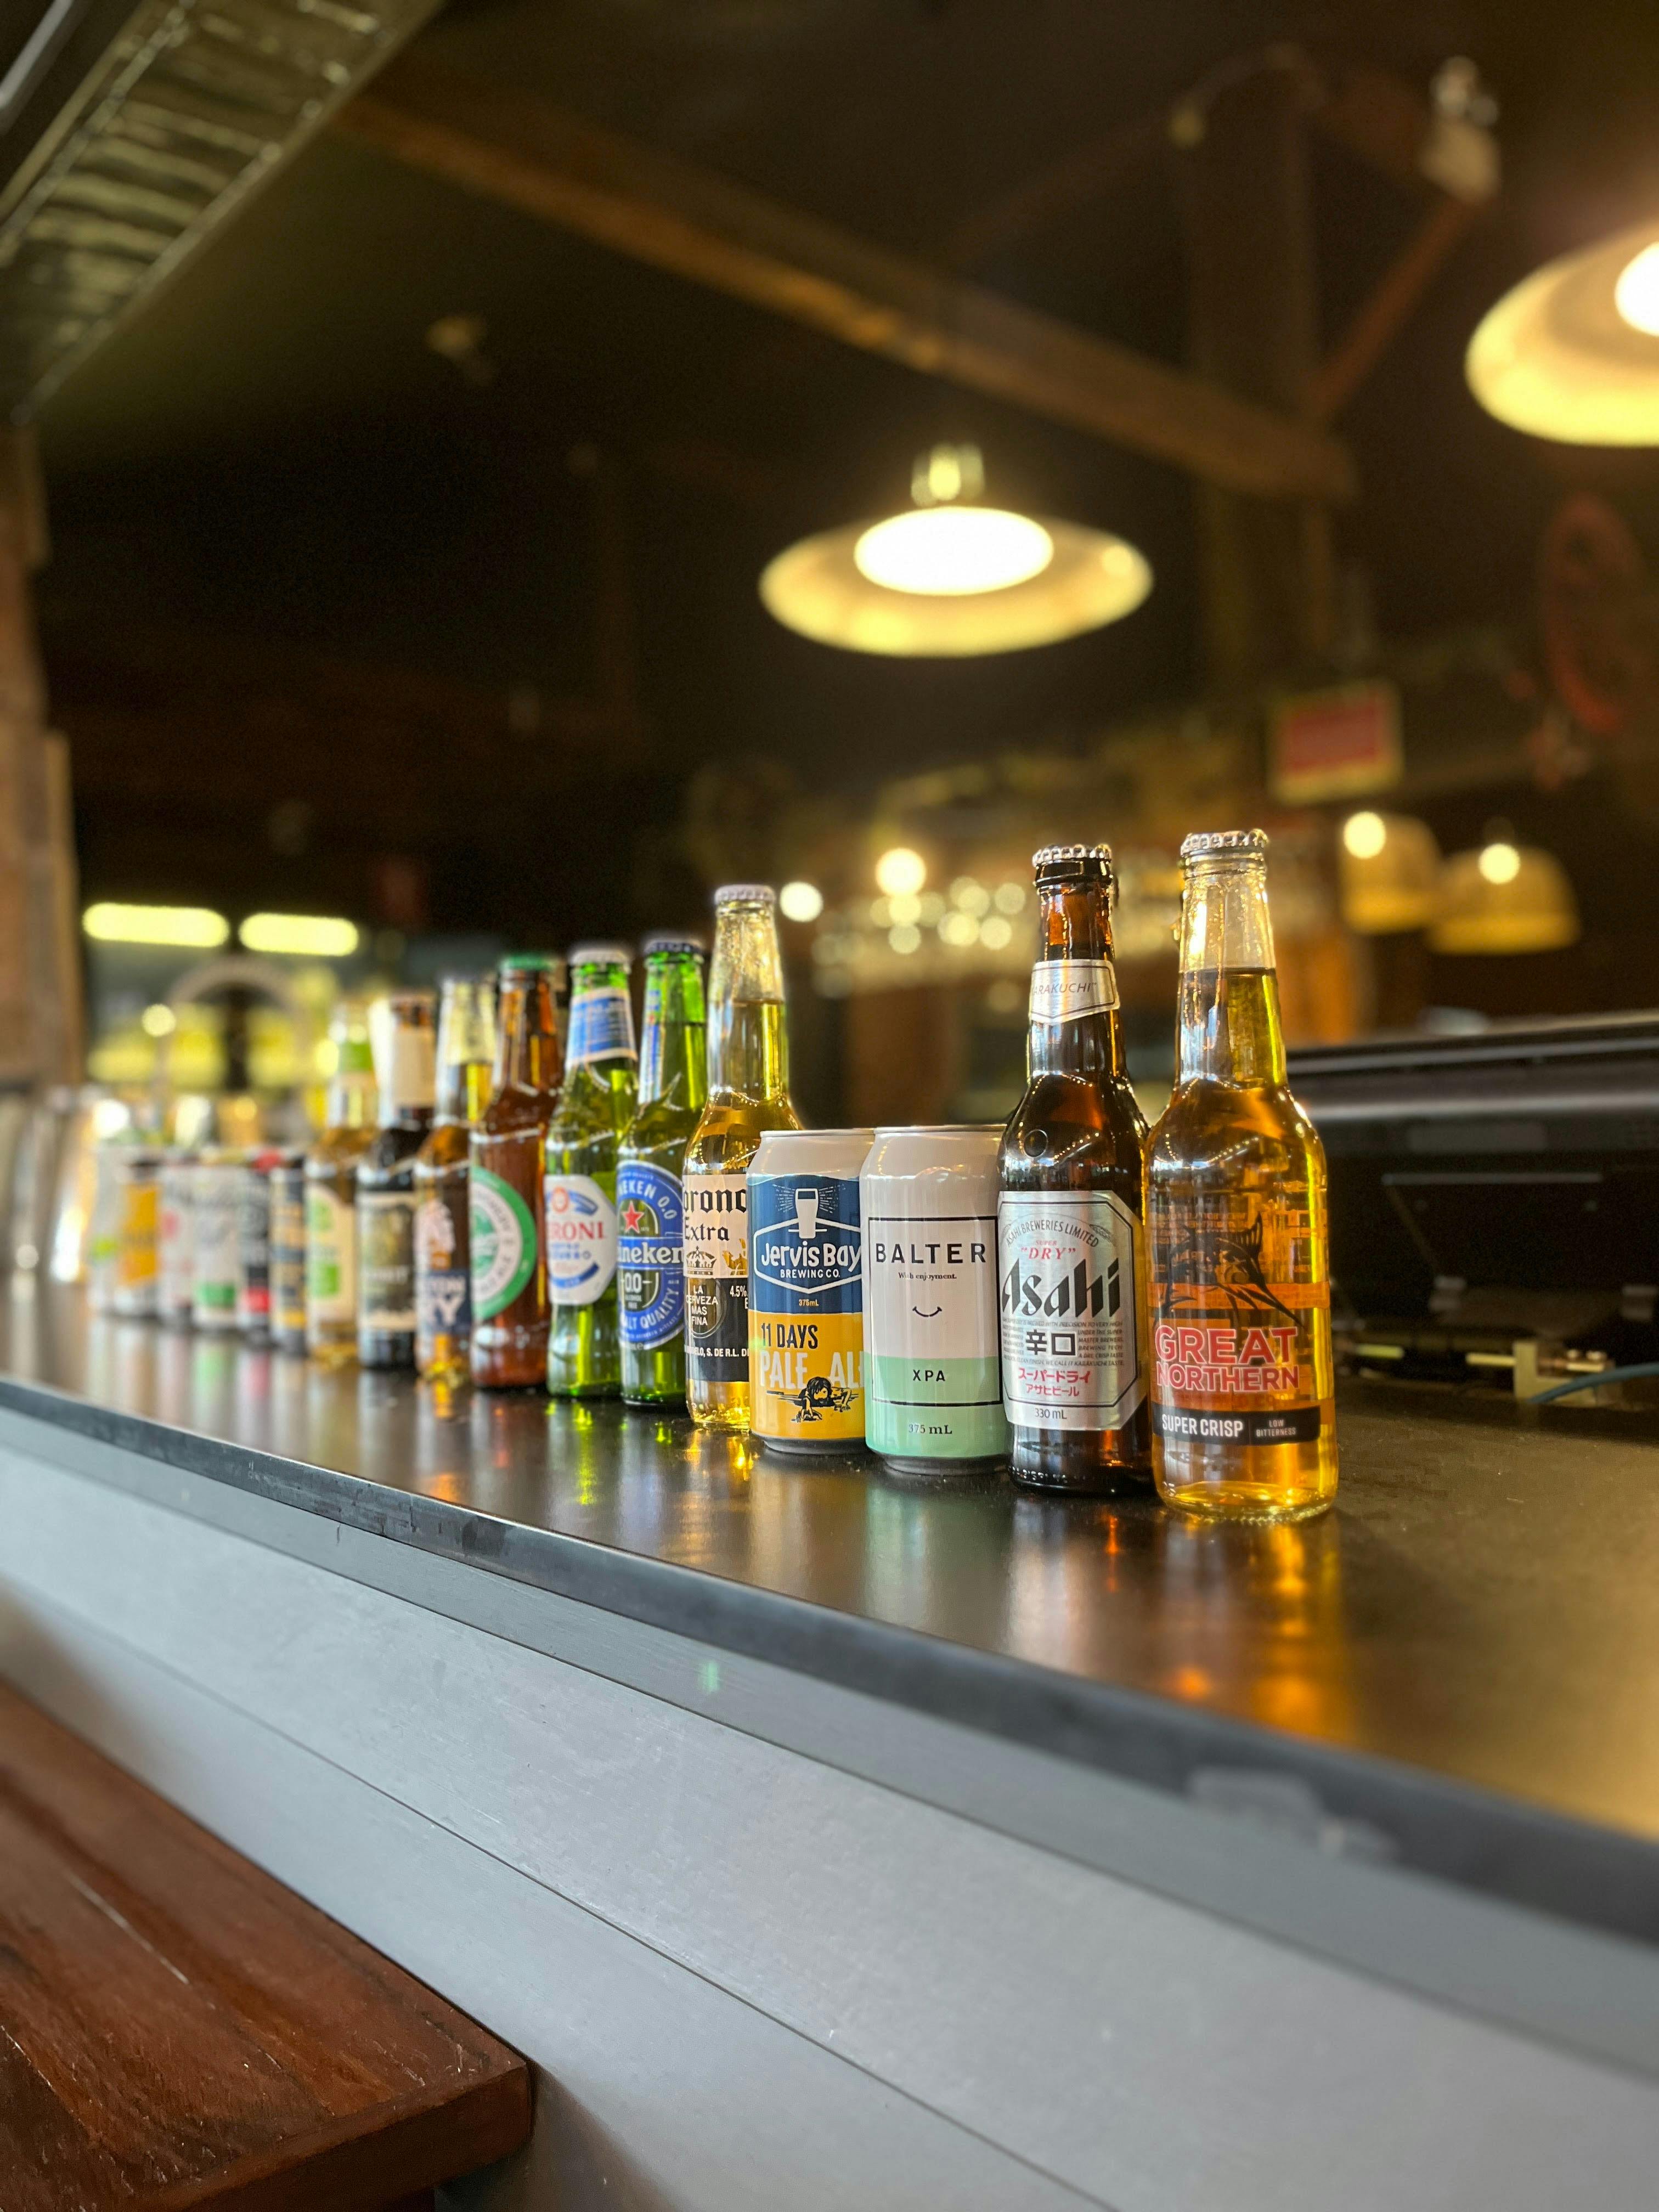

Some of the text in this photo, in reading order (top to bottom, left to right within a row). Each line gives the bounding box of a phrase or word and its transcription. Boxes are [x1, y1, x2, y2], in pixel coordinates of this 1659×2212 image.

[657, 1195, 677, 1220] 0.0
[549, 1221, 606, 1240] RONI
[685, 1217, 730, 1241] Extra
[1006, 1220, 1099, 1248] ASAHI BREWERIES LIMITED
[618, 1240, 684, 1264] ineken
[761, 1240, 861, 1272] Jervis Bay
[876, 1243, 986, 1263] BALTER
[780, 1269, 840, 1278] BREWING CO.
[916, 1273, 957, 1281] enjoyment.
[693, 1285, 704, 1294] LA
[730, 1285, 748, 1297] 4.5%
[1002, 1257, 1121, 1318] Asahi
[640, 1288, 679, 1329] QUALITY
[686, 1294, 719, 1305] CERVEZA
[691, 1306, 707, 1316] MAS
[691, 1316, 708, 1326] FINA
[761, 1323, 818, 1349] 11 DAYS
[1026, 1329, 1076, 1356] 辛口
[1155, 1325, 1298, 1365] GREAT
[707, 1347, 713, 1357] S.
[714, 1348, 724, 1357] DE
[725, 1348, 740, 1357] R.L.
[759, 1350, 808, 1389] PALE
[913, 1369, 945, 1381] XPA
[1018, 1368, 1091, 1383] スーパードライ
[1156, 1361, 1299, 1392] NORTHERN
[1025, 1384, 1080, 1396] アサヒビール
[1035, 1408, 1068, 1419] 330 mL
[909, 1424, 953, 1435] 375 mL
[1162, 1414, 1243, 1437] SUPER CRISP
[1256, 1427, 1296, 1437] BITTERNESS
